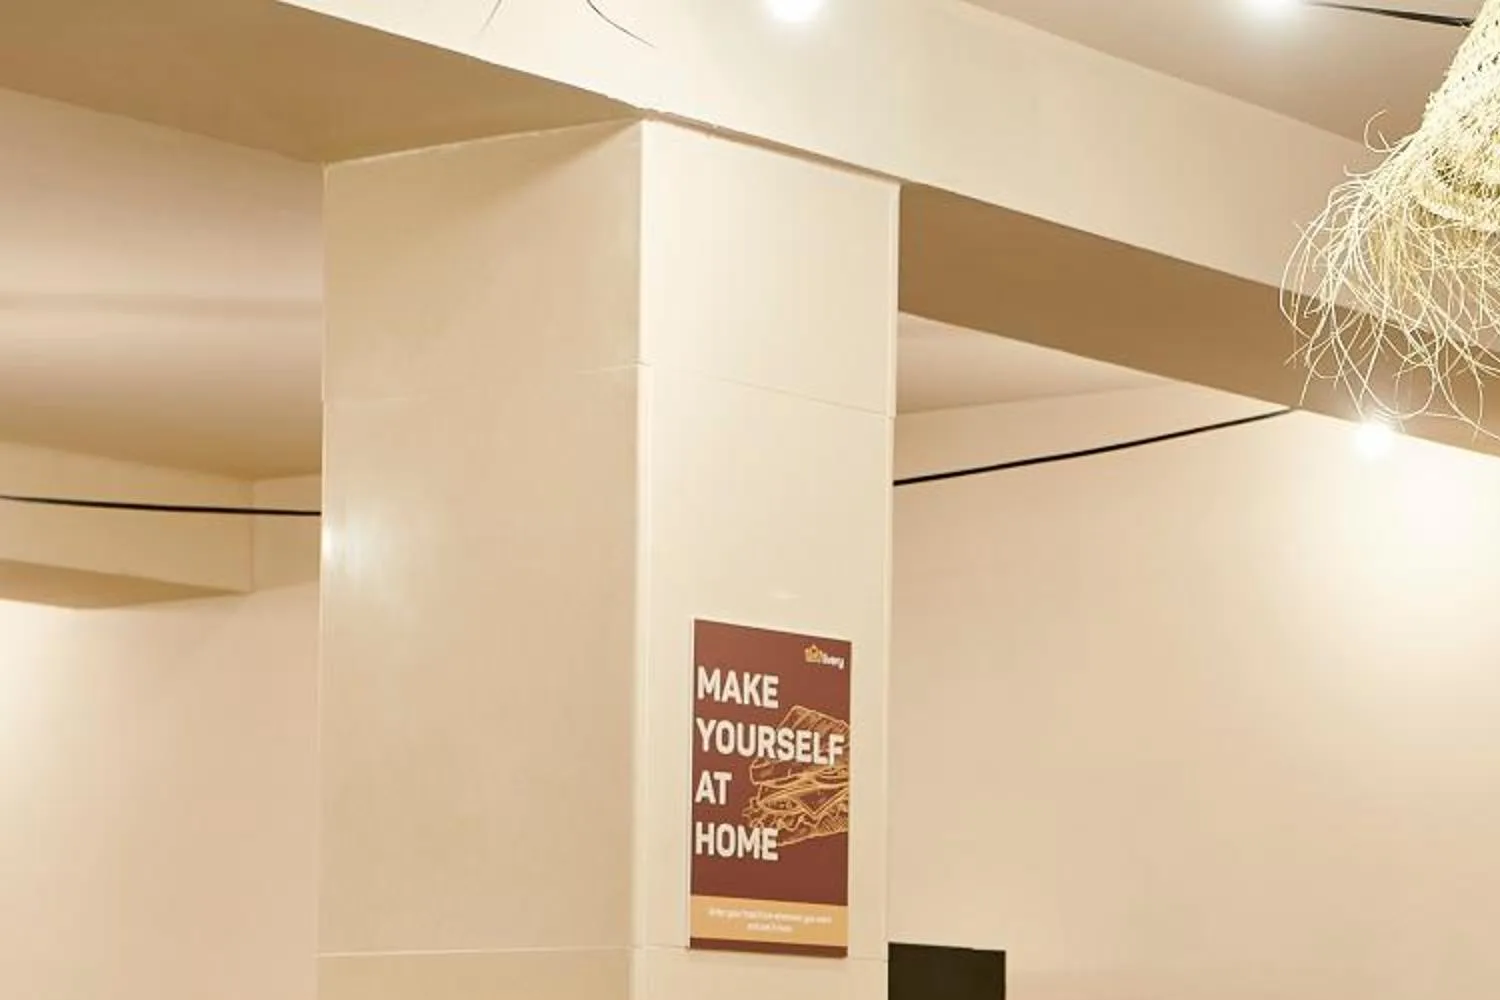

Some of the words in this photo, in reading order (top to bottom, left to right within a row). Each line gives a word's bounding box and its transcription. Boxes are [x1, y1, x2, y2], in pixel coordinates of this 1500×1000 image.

[697, 666, 779, 709] MAKE
[696, 717, 844, 767] YOURSELF
[695, 769, 732, 805] AT
[695, 821, 779, 861] HOME
